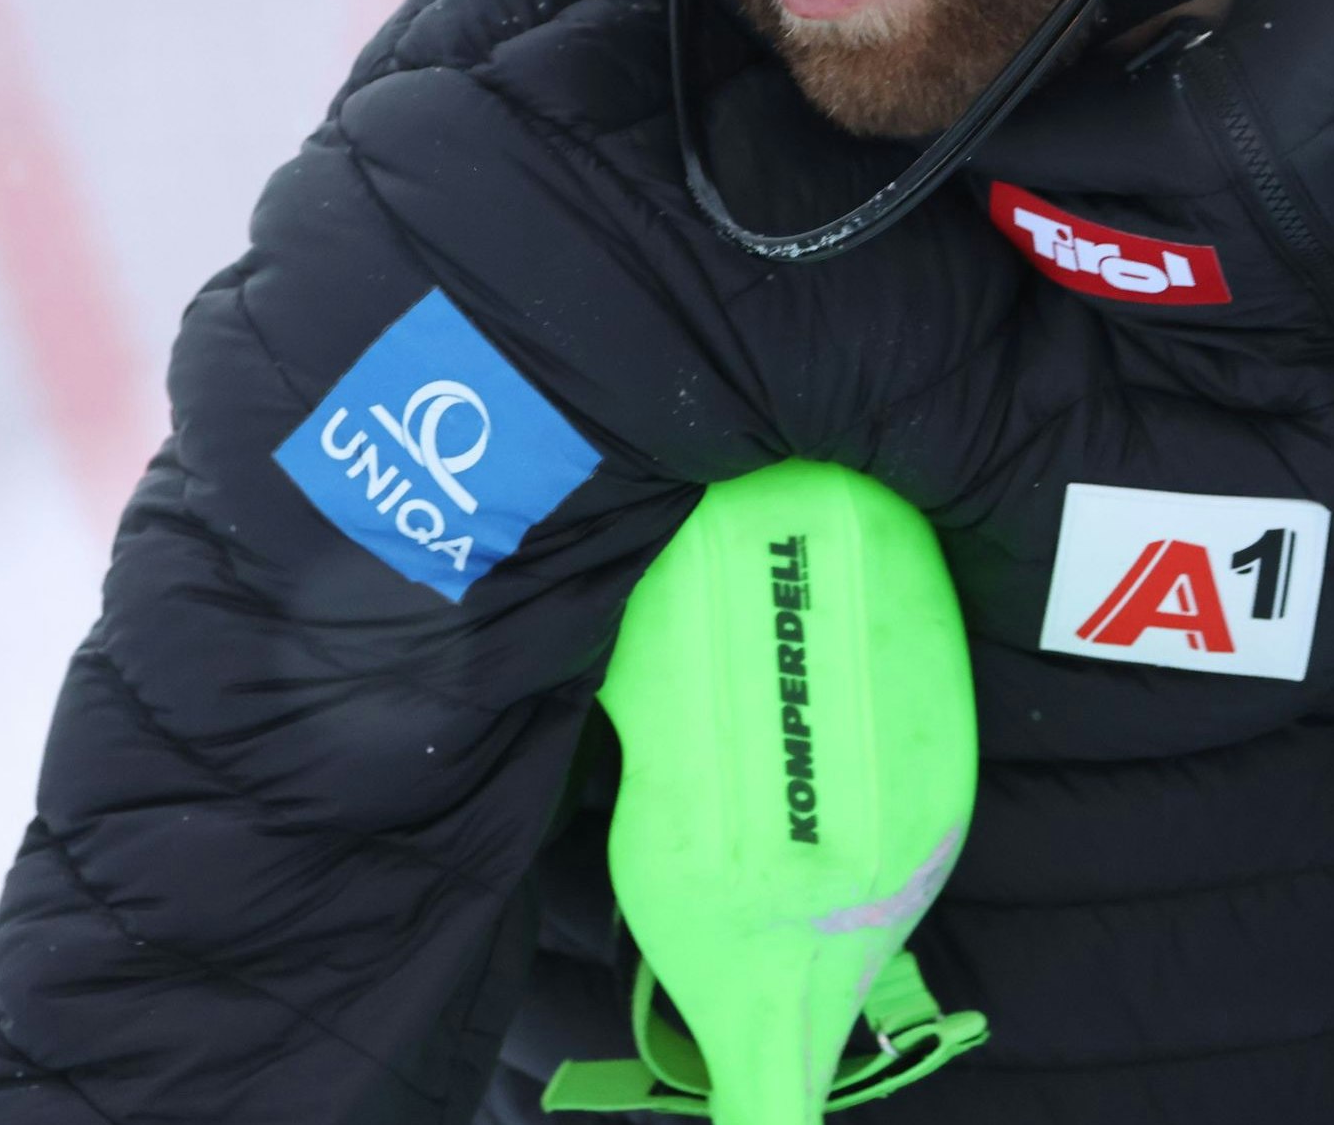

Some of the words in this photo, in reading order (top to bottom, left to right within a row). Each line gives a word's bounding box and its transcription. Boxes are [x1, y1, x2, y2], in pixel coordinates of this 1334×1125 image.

[1013, 206, 1196, 294] Tirol
[320, 407, 474, 572] UNIQA
[1075, 528, 1296, 653] A1
[769, 535, 819, 845] KOMPERDELL
